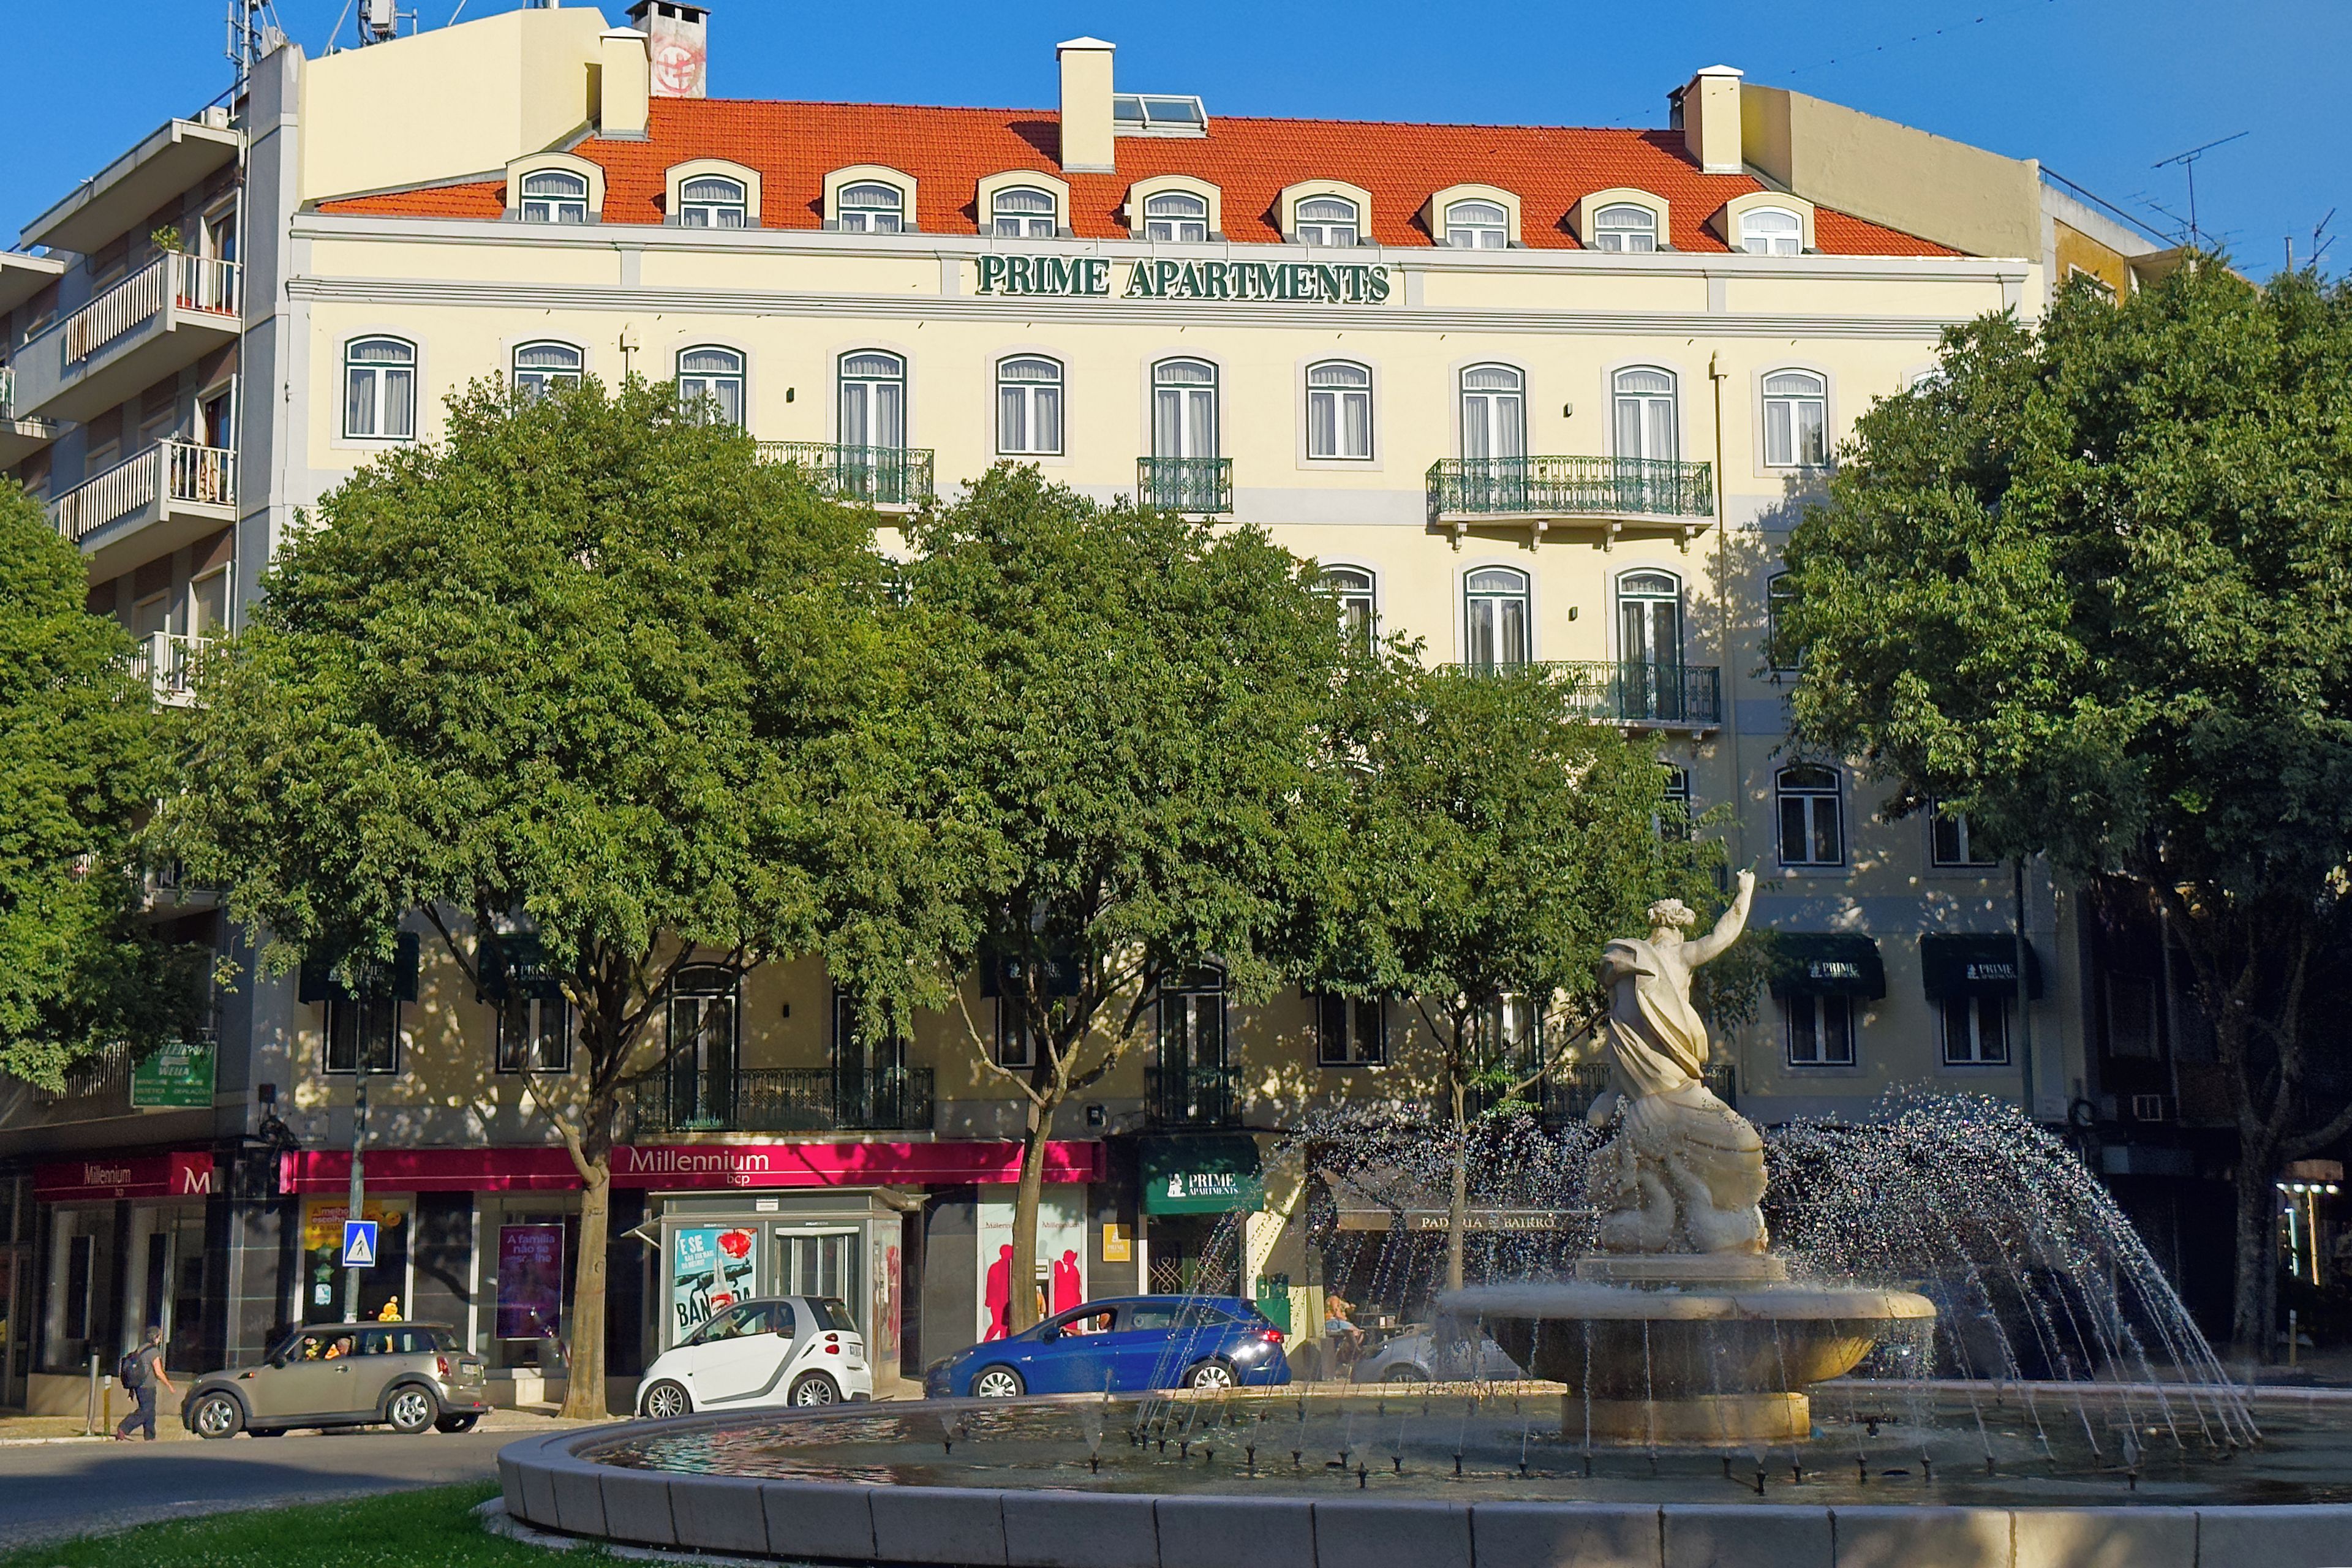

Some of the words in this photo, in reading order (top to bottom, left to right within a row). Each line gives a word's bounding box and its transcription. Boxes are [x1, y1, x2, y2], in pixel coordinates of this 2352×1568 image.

[978, 254, 1110, 295] PRIME
[1125, 258, 1390, 304] APARTMENTS
[1822, 962, 1858, 973] PRIME
[1979, 963, 2014, 974] PRIME
[159, 1066, 189, 1076] WELLA
[630, 1146, 769, 1172] Millennium
[84, 1163, 131, 1185] Millennium
[184, 1166, 211, 1194] M
[727, 1172, 750, 1186] bcp
[1189, 1173, 1236, 1188] PRIME
[1189, 1186, 1238, 1196] APARTMENTS
[507, 1235, 516, 1244] A
[679, 1238, 688, 1256] E
[688, 1234, 704, 1254] SE
[513, 1244, 535, 1254] não
